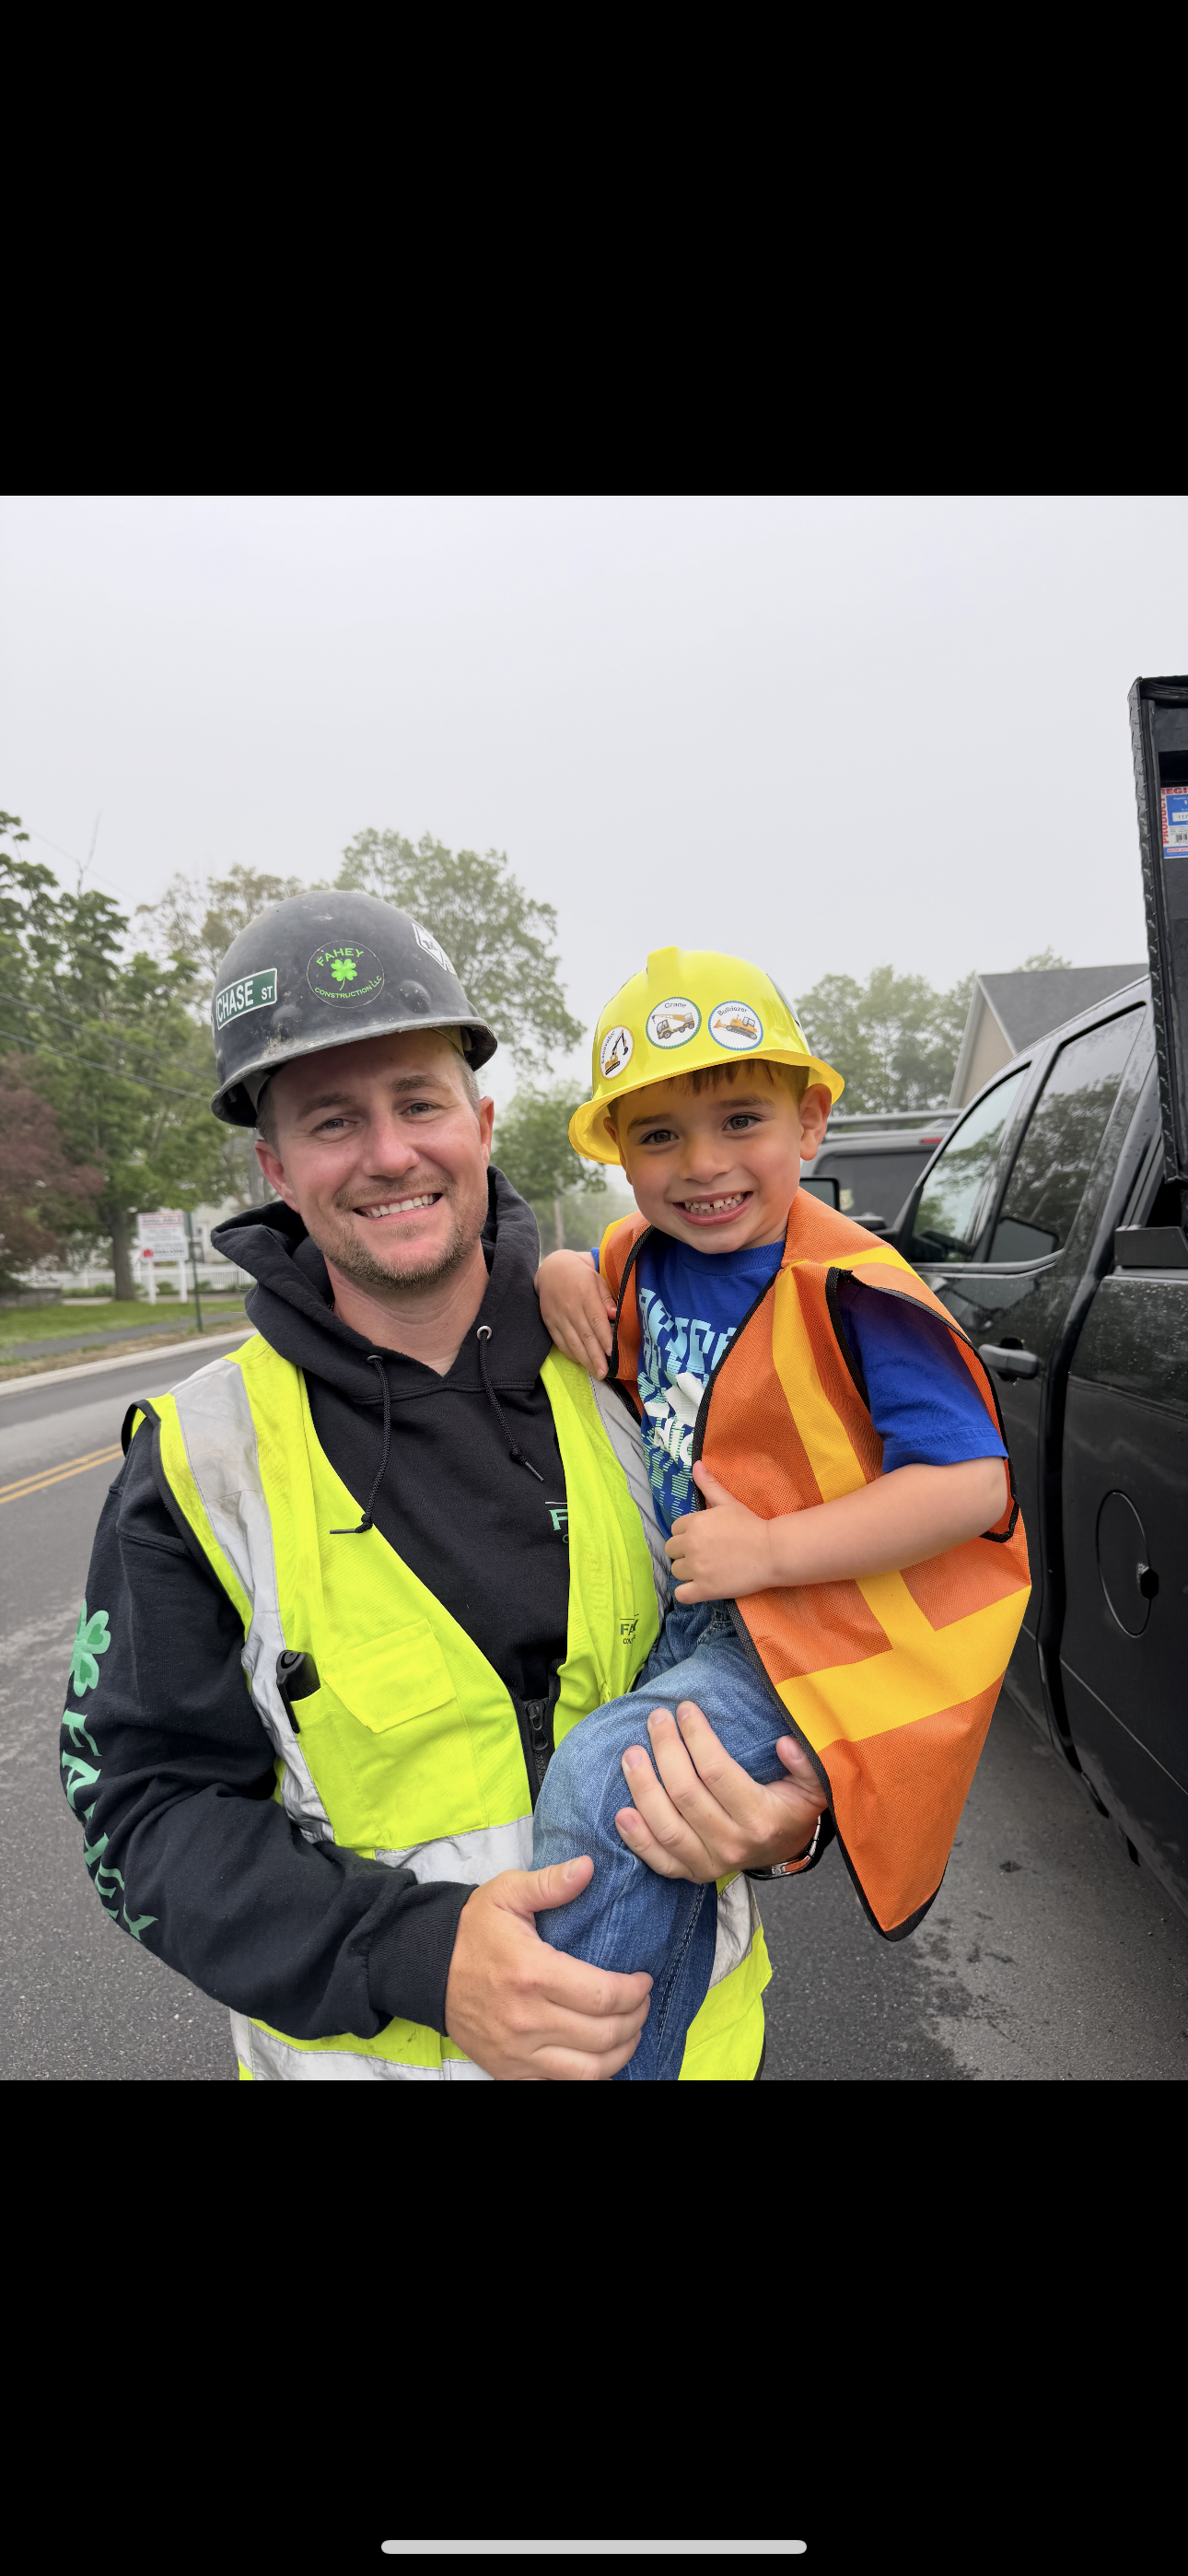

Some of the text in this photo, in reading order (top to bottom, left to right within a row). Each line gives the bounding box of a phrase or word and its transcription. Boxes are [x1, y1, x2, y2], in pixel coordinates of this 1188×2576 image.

[316, 947, 365, 967] FAHEY
[314, 975, 382, 999] CONSTRUCTION LLC
[217, 979, 274, 1023] CHASE ST
[664, 1001, 687, 1010] Crane
[716, 1005, 749, 1016] Bulldozer
